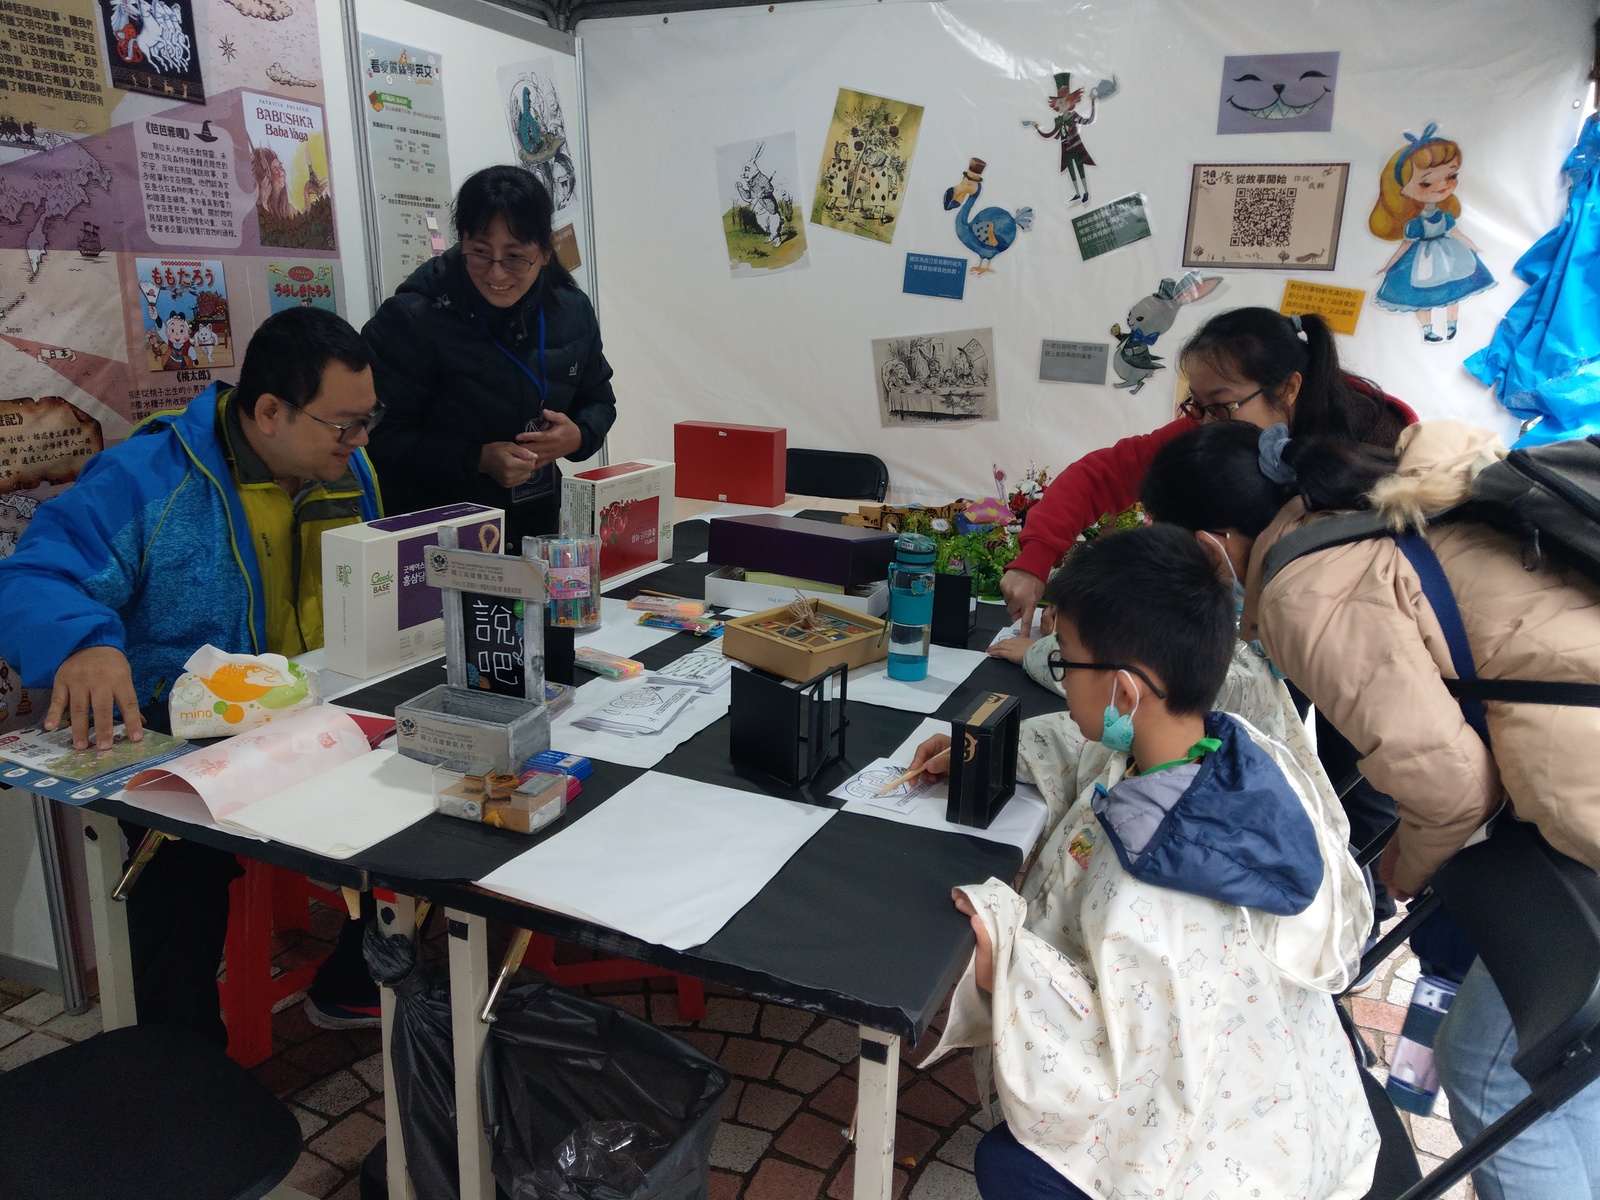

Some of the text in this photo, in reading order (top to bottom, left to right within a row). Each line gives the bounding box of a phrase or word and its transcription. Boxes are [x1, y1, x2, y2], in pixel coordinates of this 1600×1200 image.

[256, 107, 314, 129] BABUSHKA
[265, 123, 309, 143] Baba Yaga
[151, 266, 215, 288] ももたろう
[274, 282, 331, 298] うらしまたろう
[49, 349, 69, 359] 日本
[403, 562, 425, 575] 굿베이스
[371, 570, 394, 585] Good
[373, 582, 390, 594] BASE
[472, 599, 518, 685] 說吧
